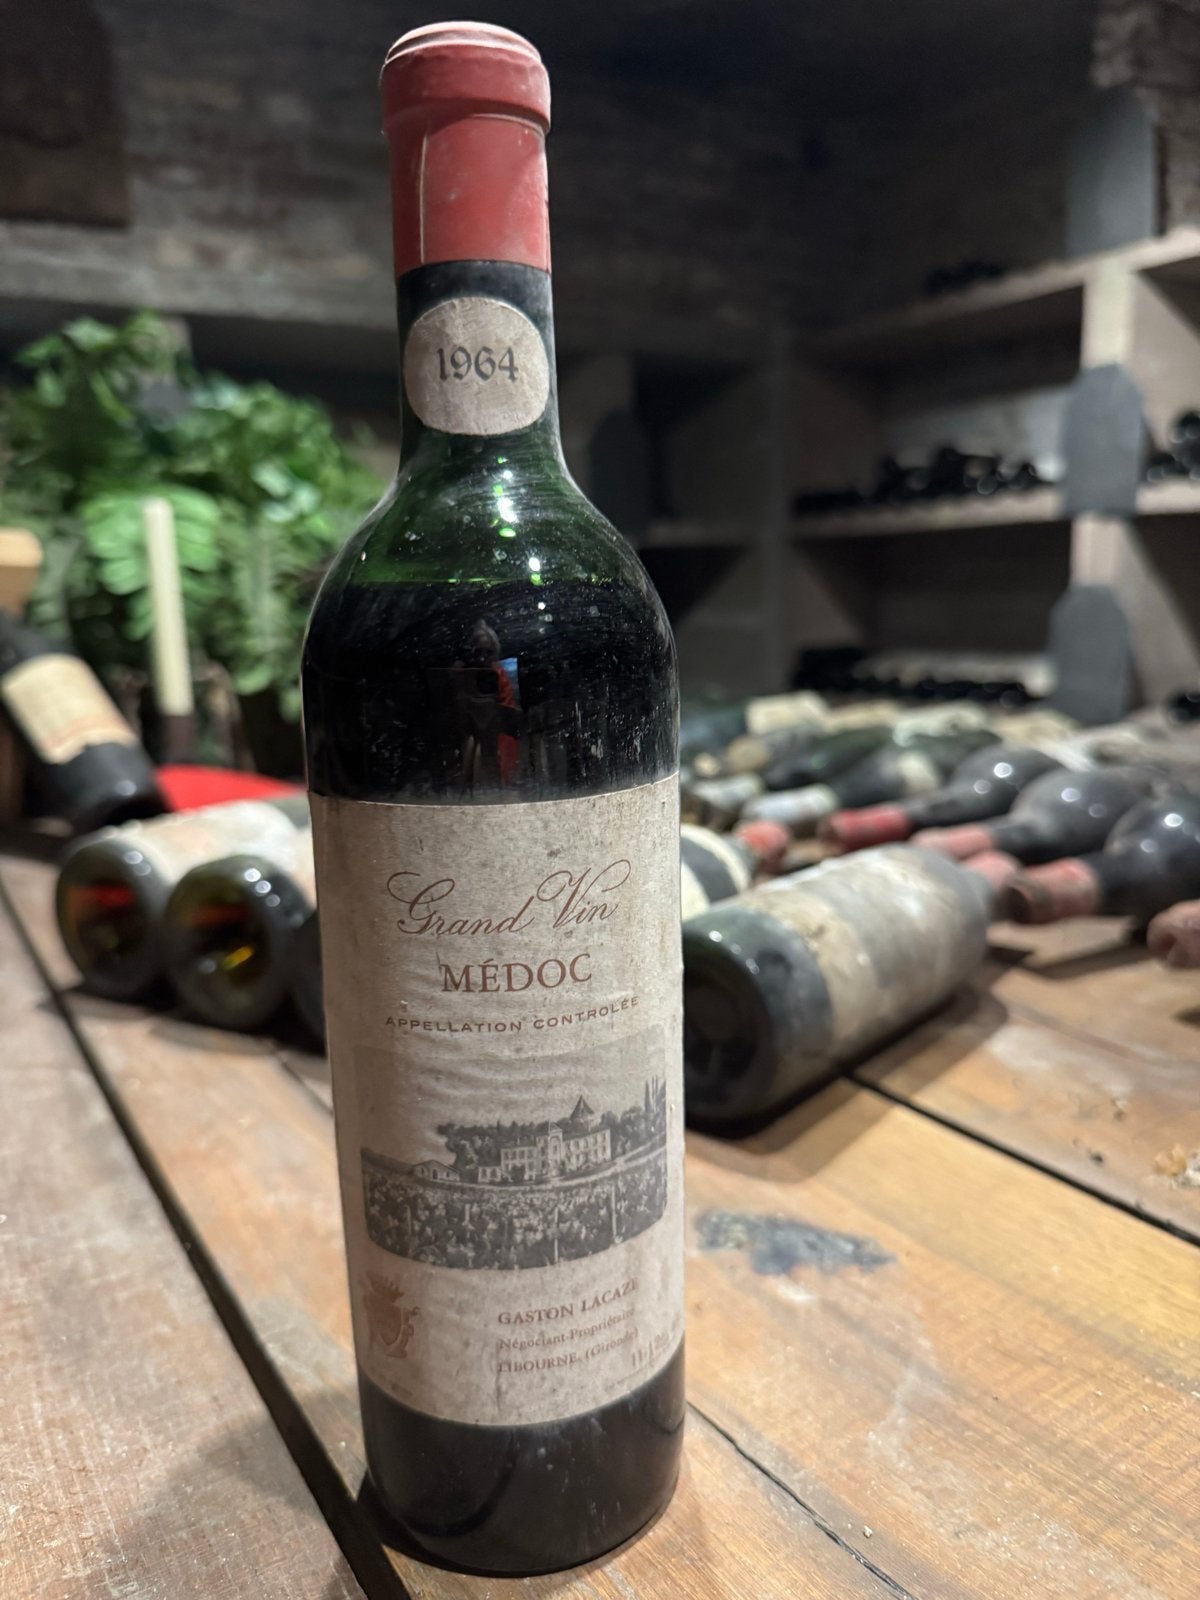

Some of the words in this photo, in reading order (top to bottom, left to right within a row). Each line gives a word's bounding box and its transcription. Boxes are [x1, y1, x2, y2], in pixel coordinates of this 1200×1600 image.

[436, 346, 519, 383] 1964
[386, 871, 537, 936] Grand
[535, 858, 632, 928] Vin
[440, 953, 593, 993] MÉDOC
[385, 1015, 523, 1033] APPELLATION
[497, 1303, 574, 1326] GASTON
